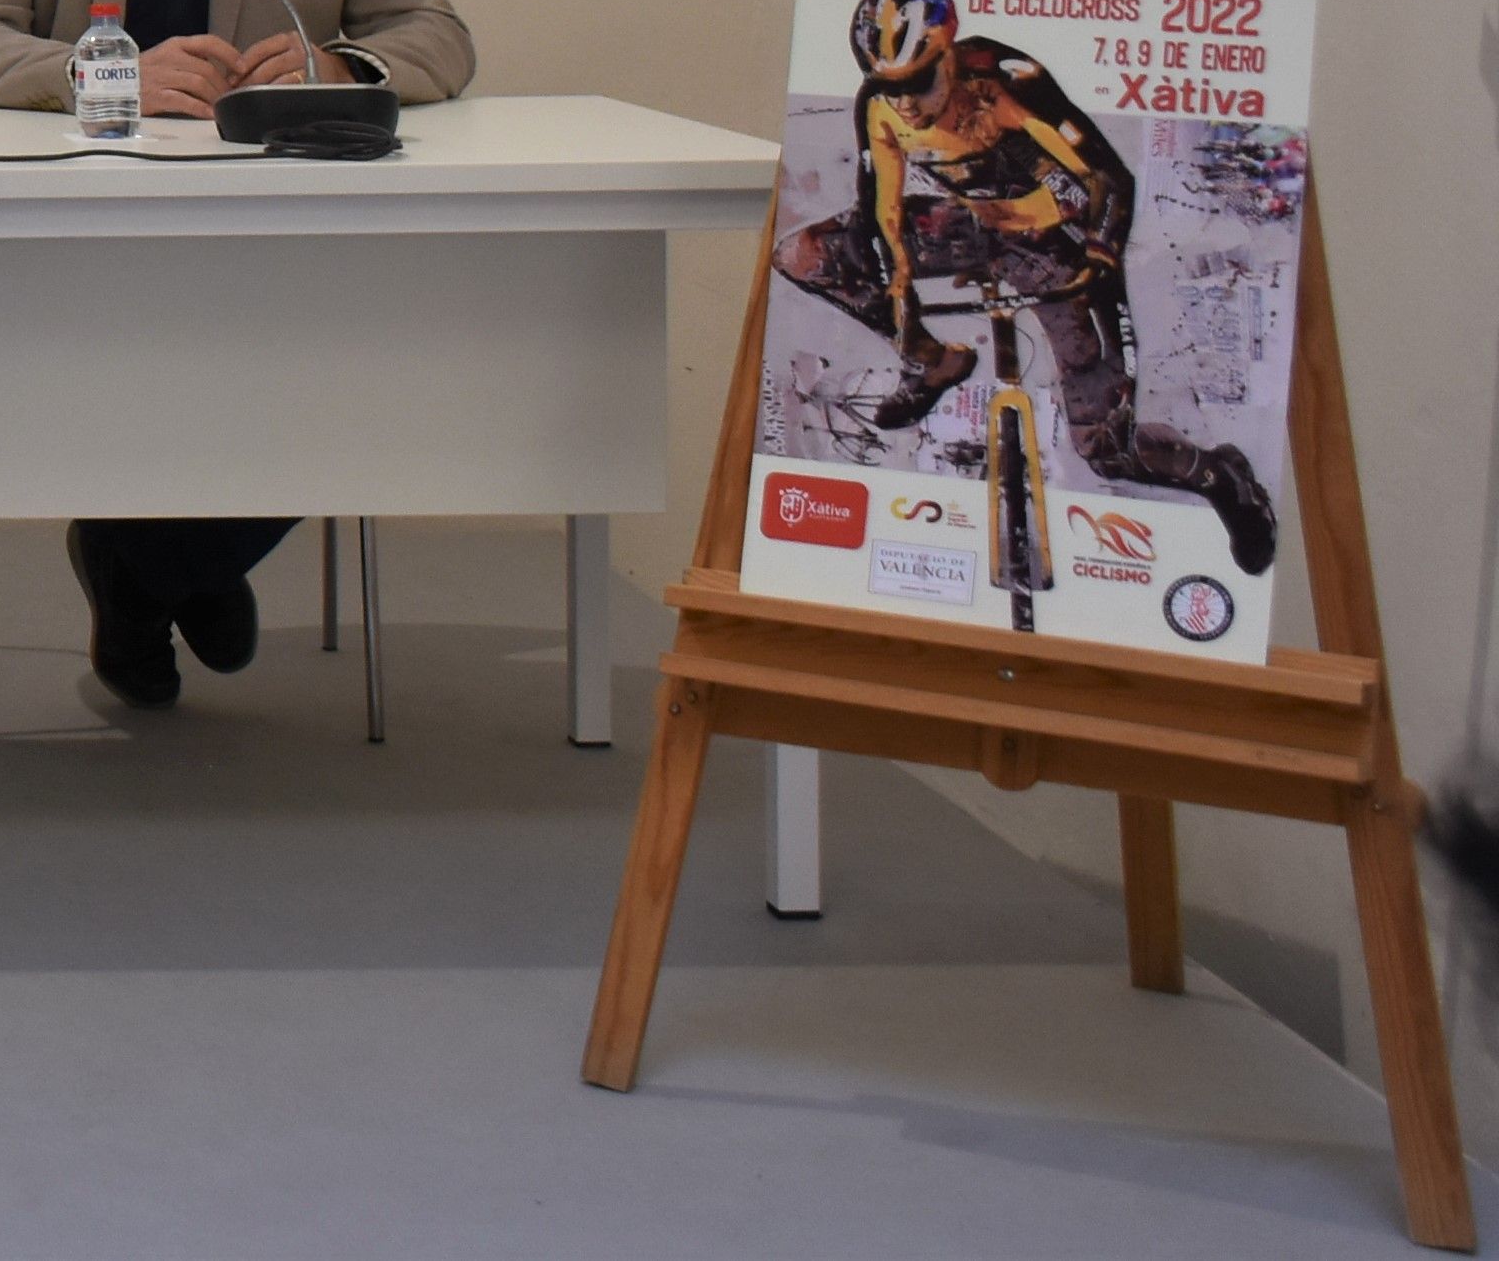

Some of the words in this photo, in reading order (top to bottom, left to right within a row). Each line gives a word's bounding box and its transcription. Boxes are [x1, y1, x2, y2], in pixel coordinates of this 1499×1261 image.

[1163, 41, 1189, 69] DE
[1201, 42, 1266, 74] ENERO
[95, 67, 137, 80] CORTES
[1116, 72, 1266, 118] Xàtiva
[1073, 563, 1151, 585] CICLISMO
